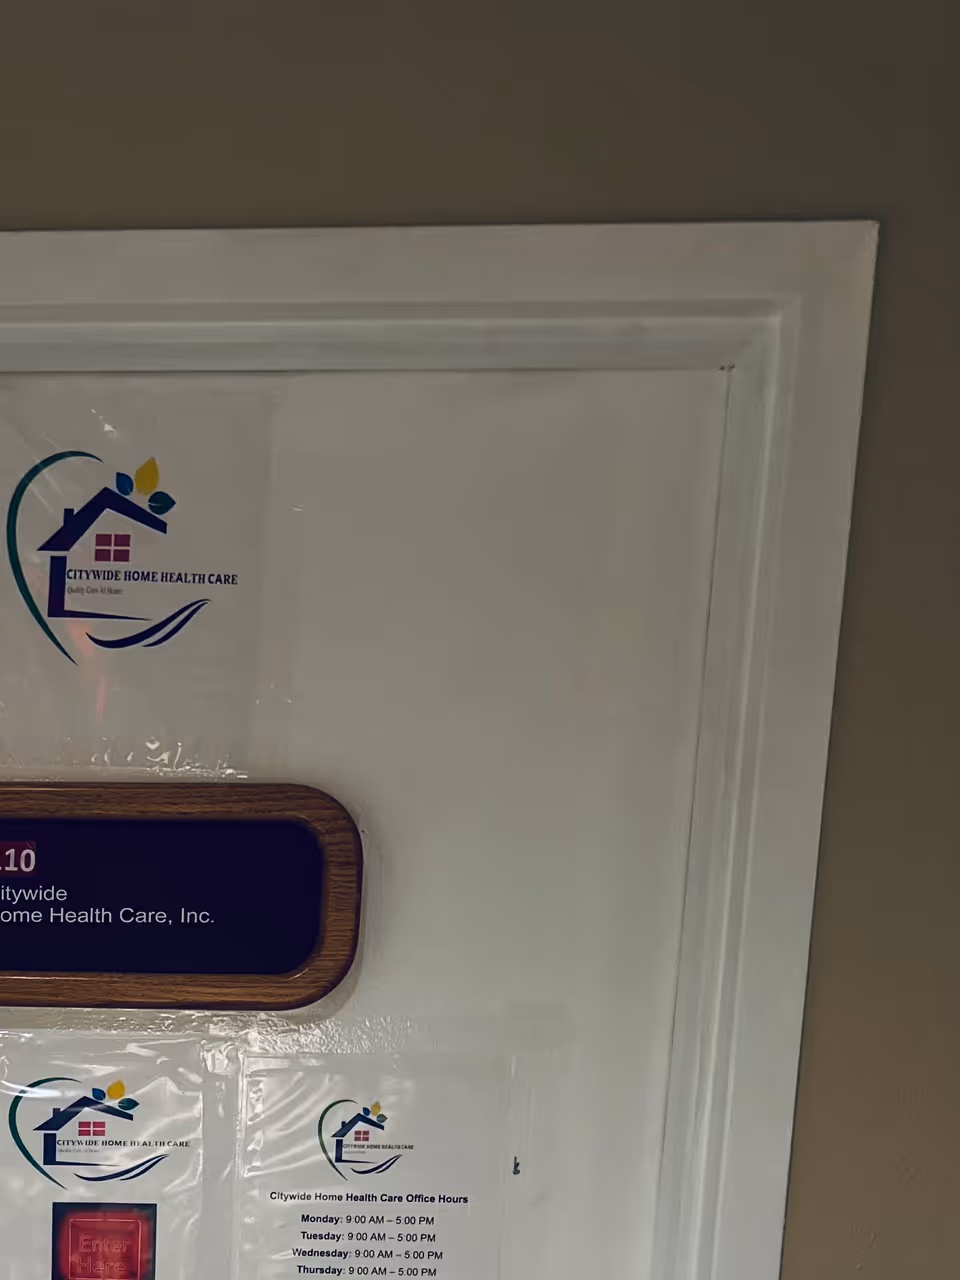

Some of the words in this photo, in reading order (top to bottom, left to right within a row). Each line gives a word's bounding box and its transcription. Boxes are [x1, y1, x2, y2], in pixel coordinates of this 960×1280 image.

[67, 569, 120, 581] CITYWIDE
[124, 571, 158, 582] HOME
[161, 572, 205, 584] HEALTH
[208, 574, 238, 585] CARE
[50, 908, 112, 923] Health
[119, 908, 172, 925] Care,
[181, 908, 215, 923] Inc.
[270, 1192, 312, 1203] Citywide
[314, 1193, 343, 1202] Home
[346, 1193, 377, 1202] Health
[380, 1194, 403, 1203] Care
[406, 1194, 435, 1203] Office
[438, 1195, 468, 1204] Hours
[301, 1214, 343, 1225] Monday:
[346, 1215, 367, 1224] 9:00
[369, 1216, 384, 1224] AM
[396, 1216, 416, 1225] 5:00
[419, 1216, 434, 1225] PM
[301, 1232, 344, 1242] Tuesday:
[348, 1233, 368, 1241] 9:00
[370, 1233, 385, 1241] AM
[397, 1233, 418, 1242] 5:00
[420, 1234, 435, 1243] PM
[79, 1235, 131, 1253] Enter
[292, 1249, 352, 1260] Wednesday:
[355, 1250, 375, 1258] 9:00
[377, 1250, 393, 1259] AM
[404, 1250, 424, 1259] 5:00
[427, 1251, 443, 1260] PM
[76, 1256, 127, 1274] Here
[297, 1266, 346, 1276] Thursday:
[348, 1267, 369, 1275] 9:00
[371, 1267, 386, 1276] AM
[398, 1267, 418, 1276] 5:00
[421, 1268, 436, 1277] PM
